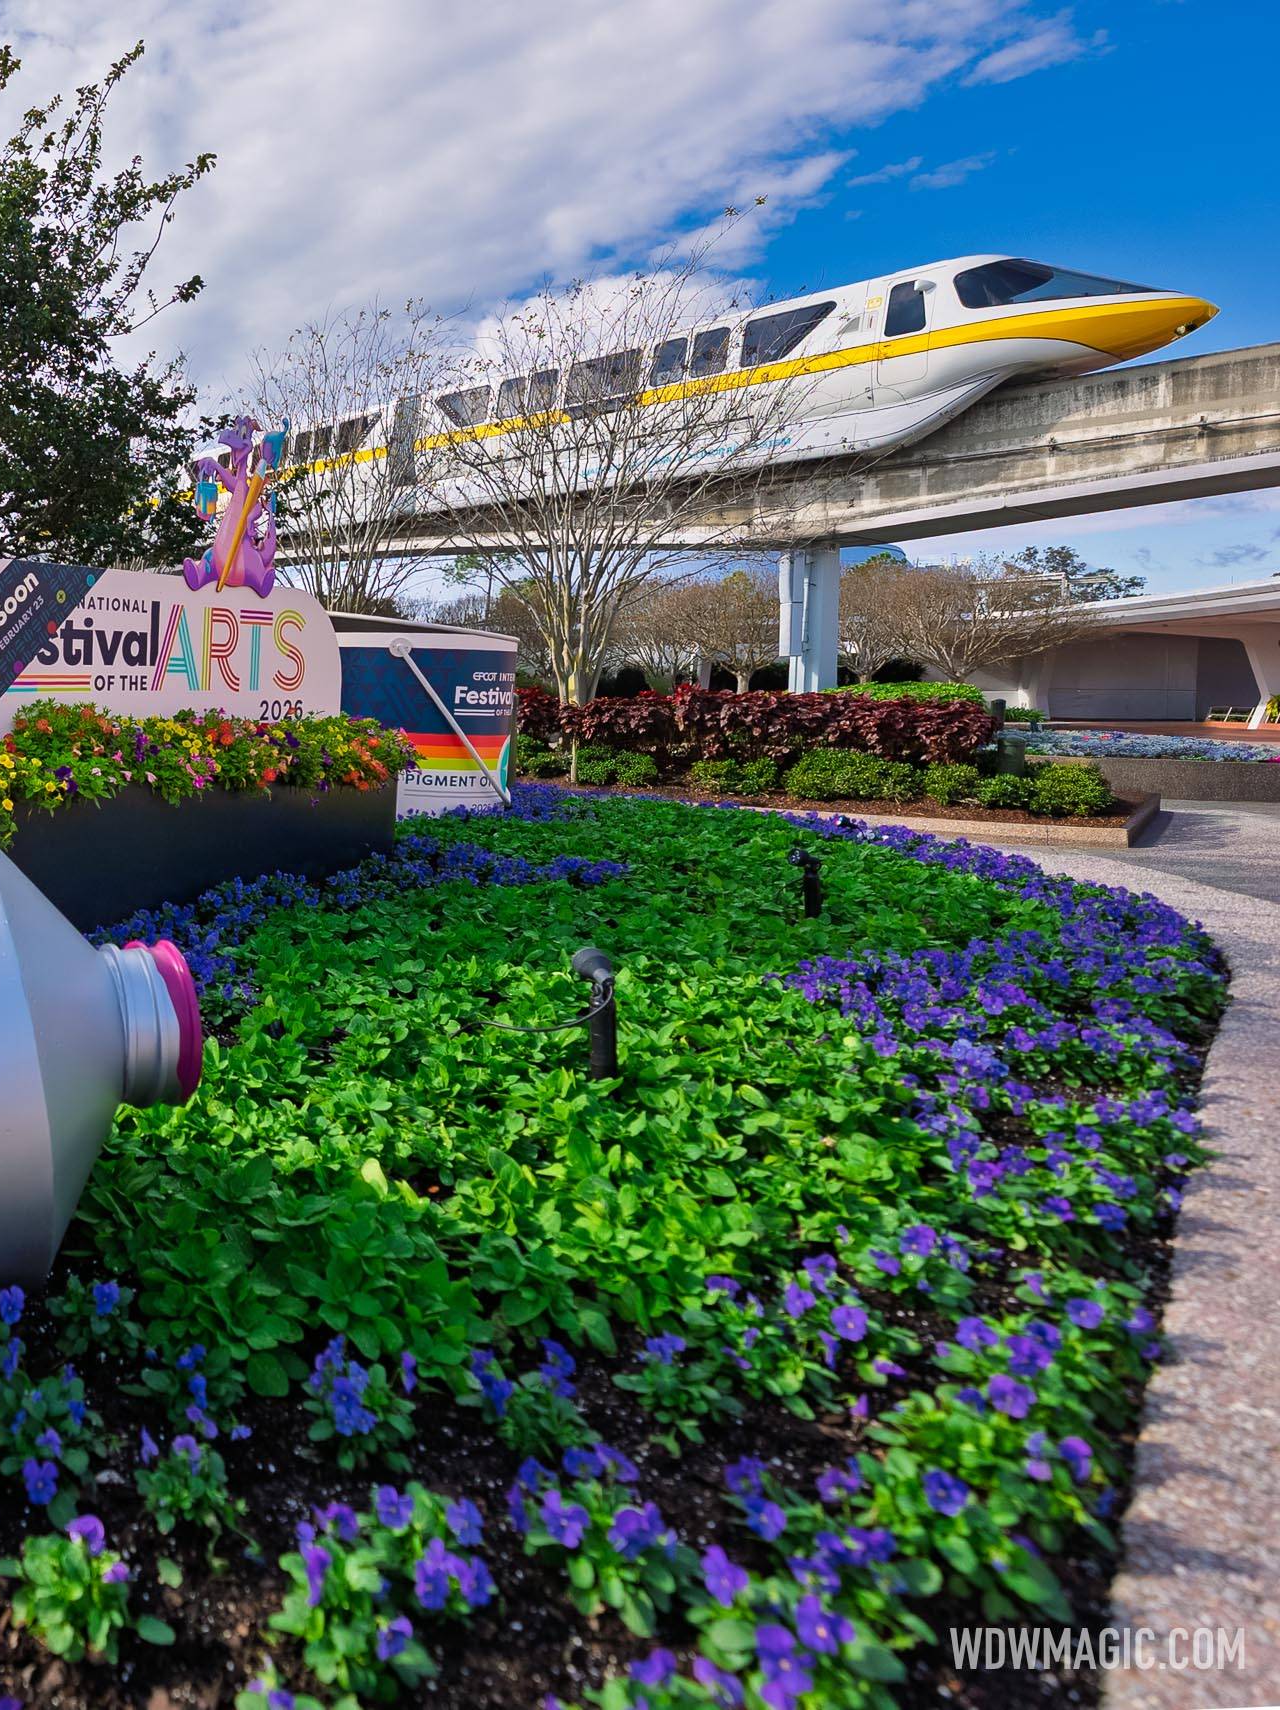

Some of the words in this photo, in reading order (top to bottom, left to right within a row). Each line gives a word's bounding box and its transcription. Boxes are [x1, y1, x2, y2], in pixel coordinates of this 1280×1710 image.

[33, 594, 45, 611] 23
[77, 597, 148, 613] NATIONAL
[36, 601, 160, 667] stival
[151, 604, 307, 692] ARTS
[94, 675, 115, 691] OF
[119, 675, 148, 691] THE
[454, 684, 514, 705] Festiva
[259, 699, 303, 720] 2026
[405, 773, 476, 788] PIGMENT
